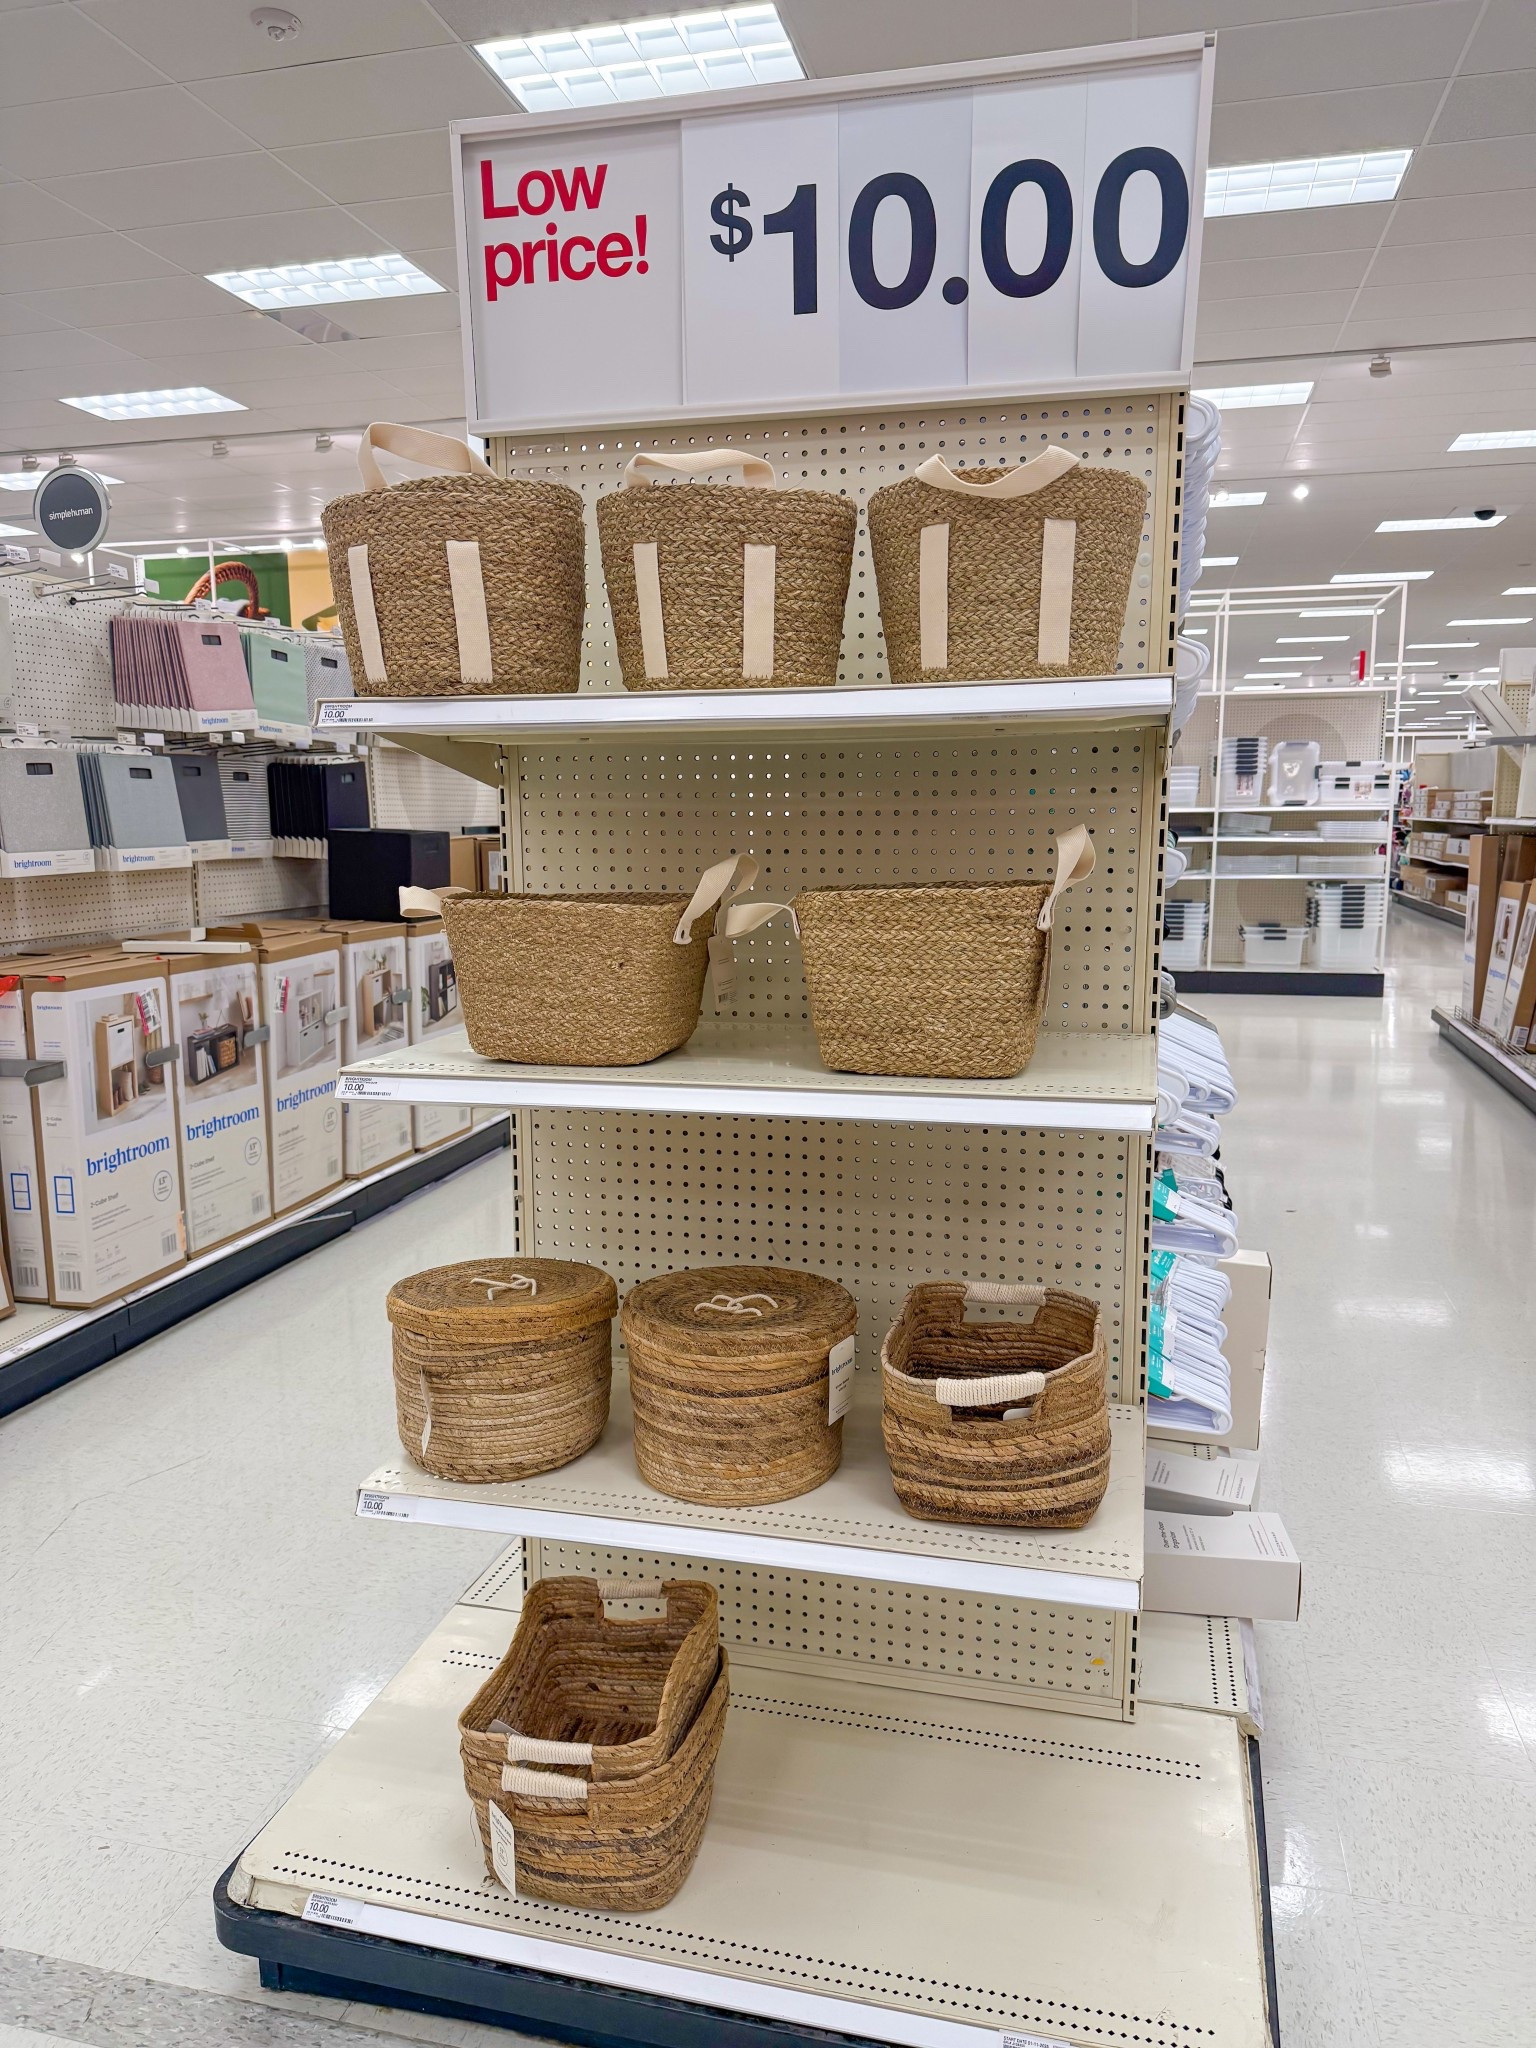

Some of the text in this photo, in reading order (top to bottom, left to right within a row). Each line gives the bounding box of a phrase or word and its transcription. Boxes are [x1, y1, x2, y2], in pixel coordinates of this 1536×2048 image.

[480, 158, 608, 220] Low
[709, 146, 1190, 316] $10.00
[483, 214, 649, 302] price!
[48, 507, 94, 520] simplehuman
[201, 717, 229, 726] brightroom
[13, 859, 52, 869] brightroom
[122, 855, 156, 864] brightroom
[343, 1083, 365, 1091] 10.00
[276, 1079, 337, 1113] brightroom
[186, 1106, 260, 1142] brightroom
[86, 1136, 171, 1177] brightroom
[363, 1501, 384, 1510] 10.00
[309, 1902, 330, 1913] 10.00
